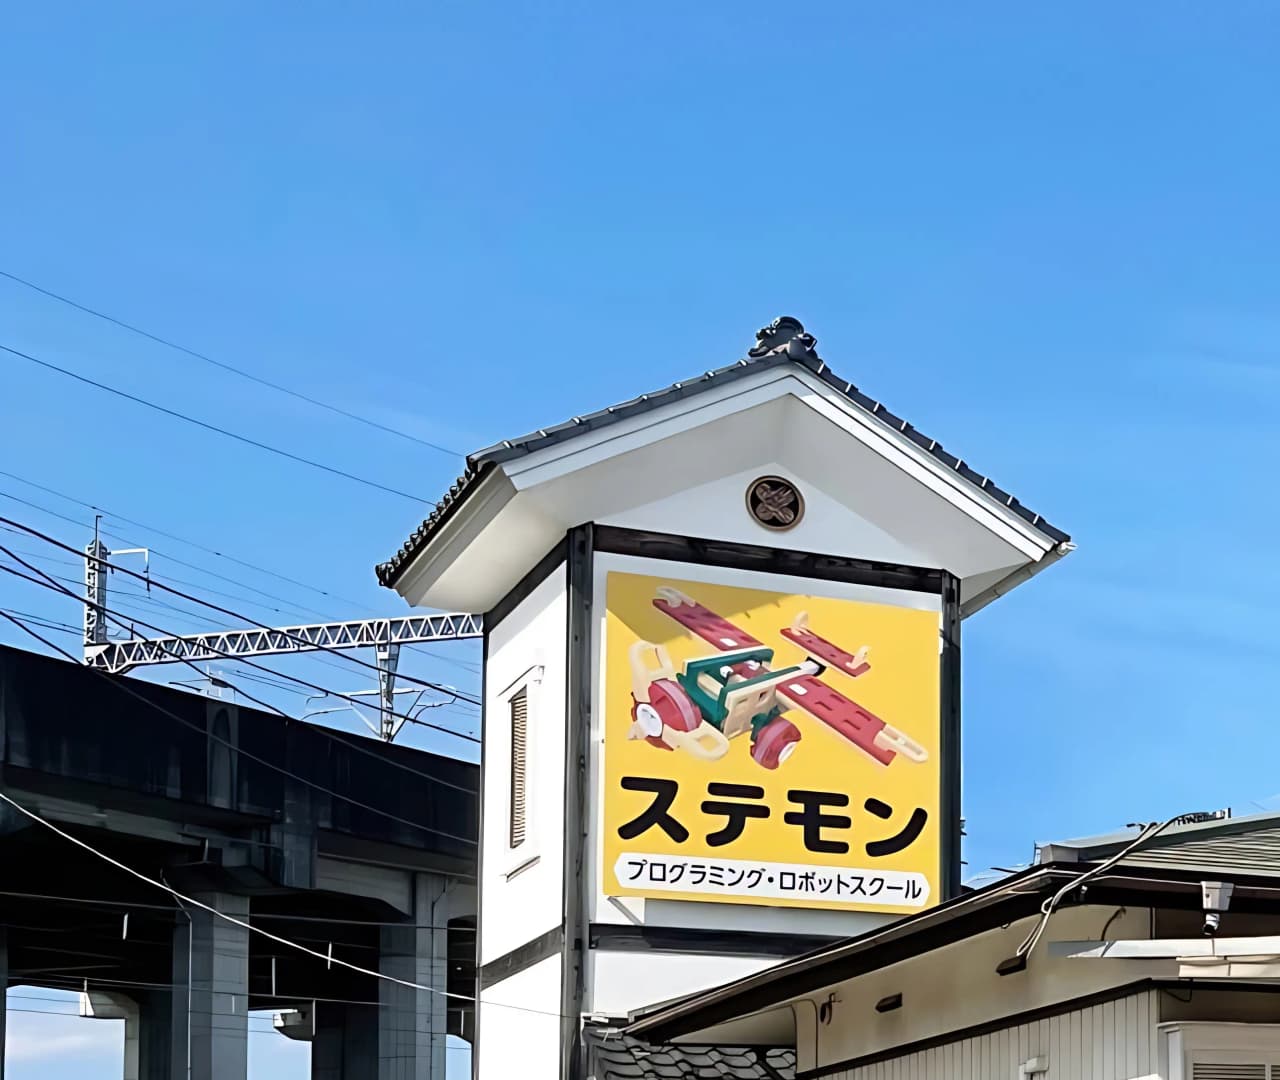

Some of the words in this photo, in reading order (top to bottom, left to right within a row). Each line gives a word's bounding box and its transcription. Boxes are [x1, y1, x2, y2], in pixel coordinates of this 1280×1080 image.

[617, 775, 929, 858] ステモン
[626, 859, 923, 900] プログラミング・ロボットスクール
